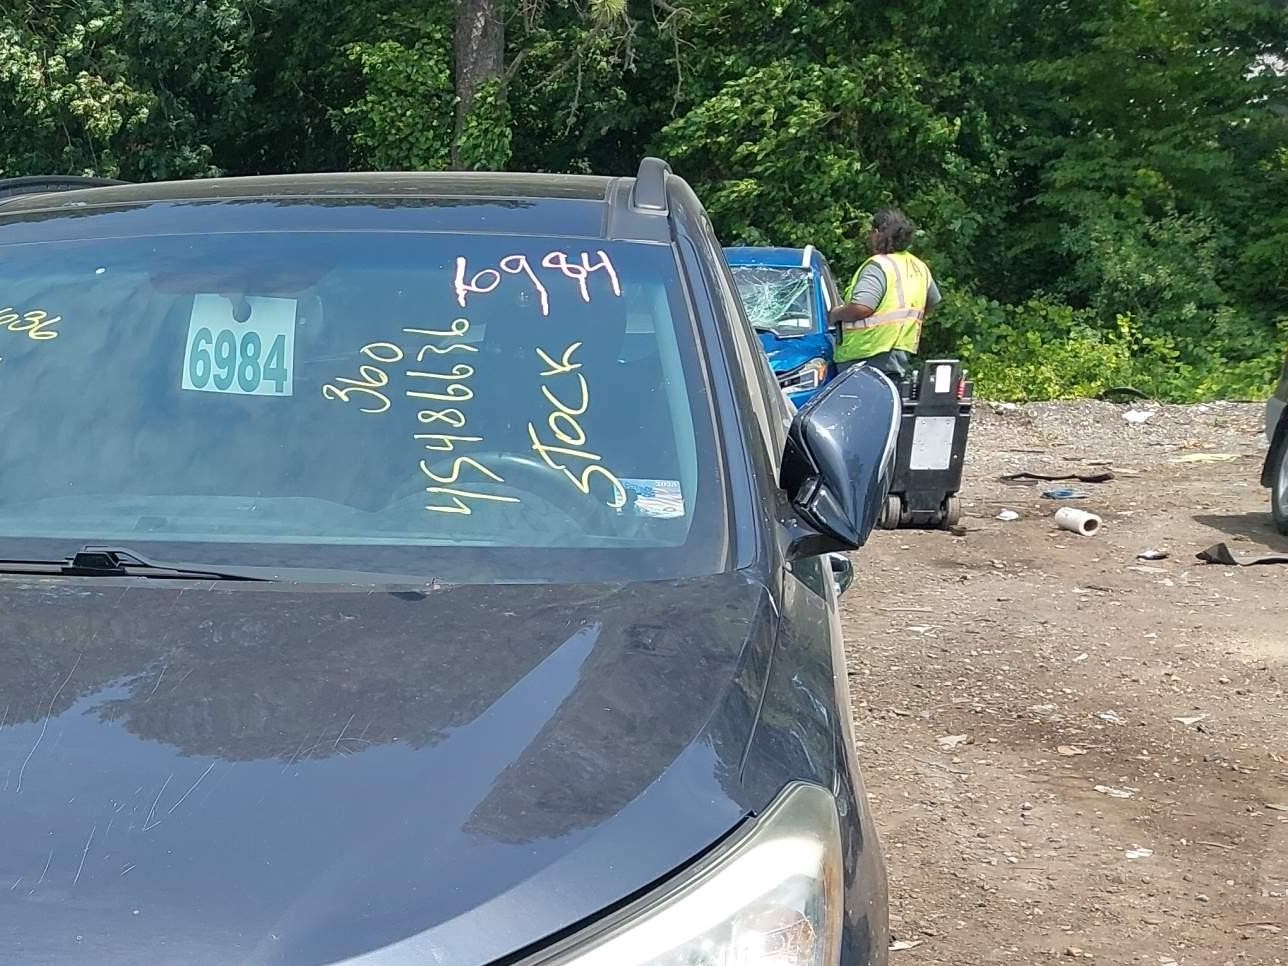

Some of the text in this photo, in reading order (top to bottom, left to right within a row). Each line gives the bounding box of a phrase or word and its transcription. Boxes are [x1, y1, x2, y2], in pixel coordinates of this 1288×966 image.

[189, 327, 288, 393] 6984
[323, 342, 404, 413] 360
[403, 318, 520, 515] 45486636
[528, 342, 626, 508] STOCK
